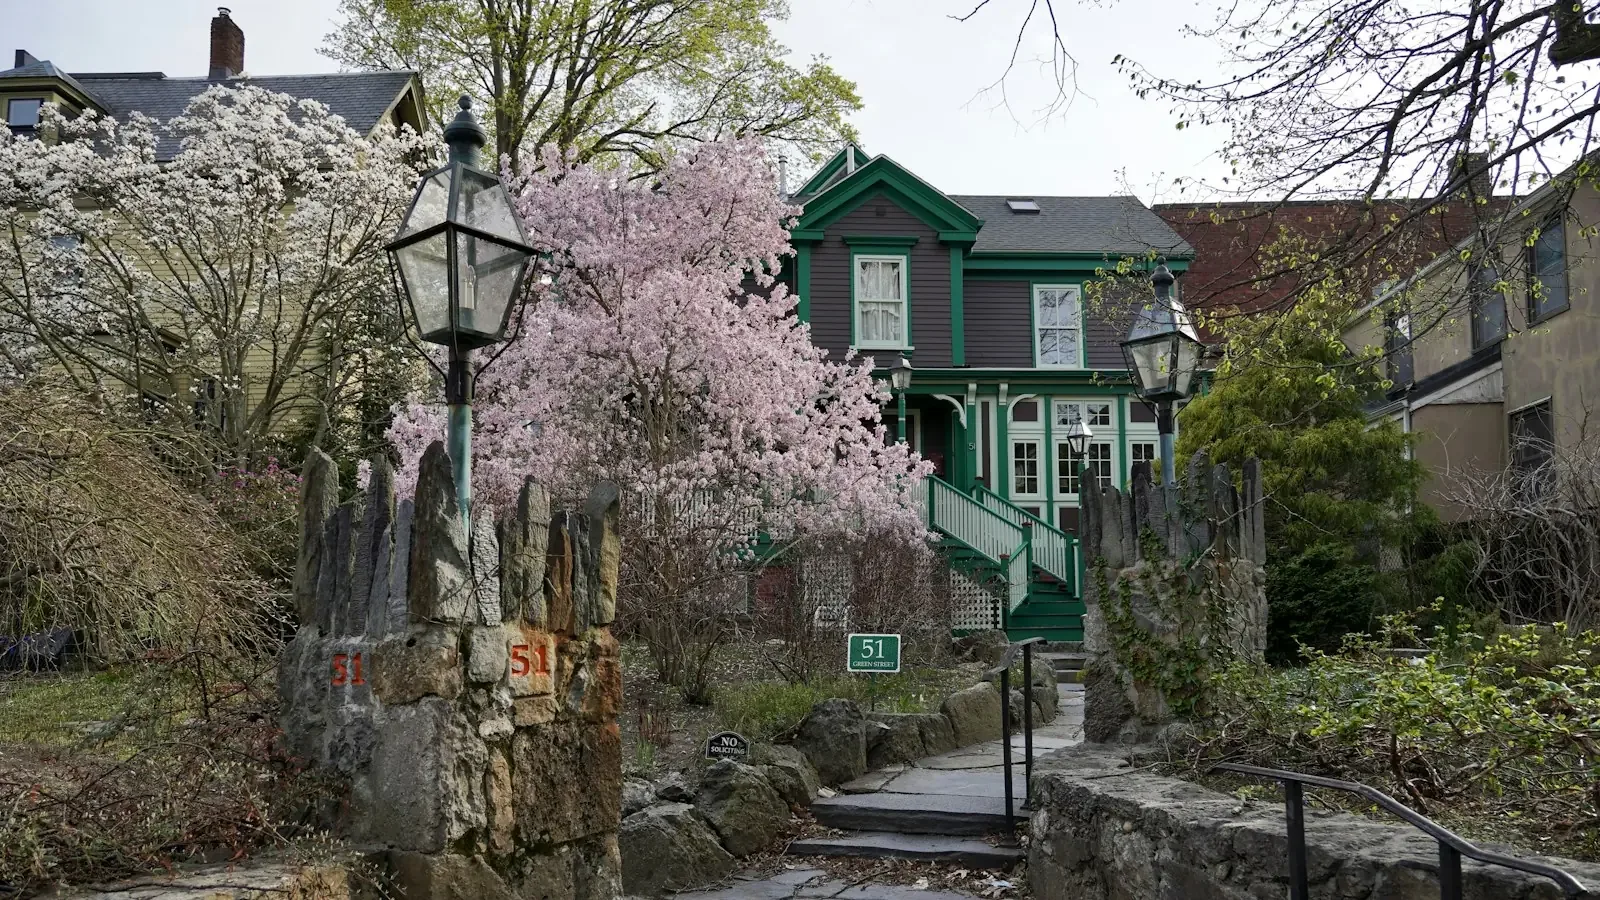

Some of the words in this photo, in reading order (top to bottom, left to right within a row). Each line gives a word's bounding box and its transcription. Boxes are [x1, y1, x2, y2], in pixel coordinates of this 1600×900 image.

[968, 442, 976, 450] 51
[861, 639, 884, 658] 51
[512, 644, 550, 676] 51
[331, 652, 367, 686] 51
[720, 736, 738, 747] NO
[710, 746, 745, 754] SOLICITING
